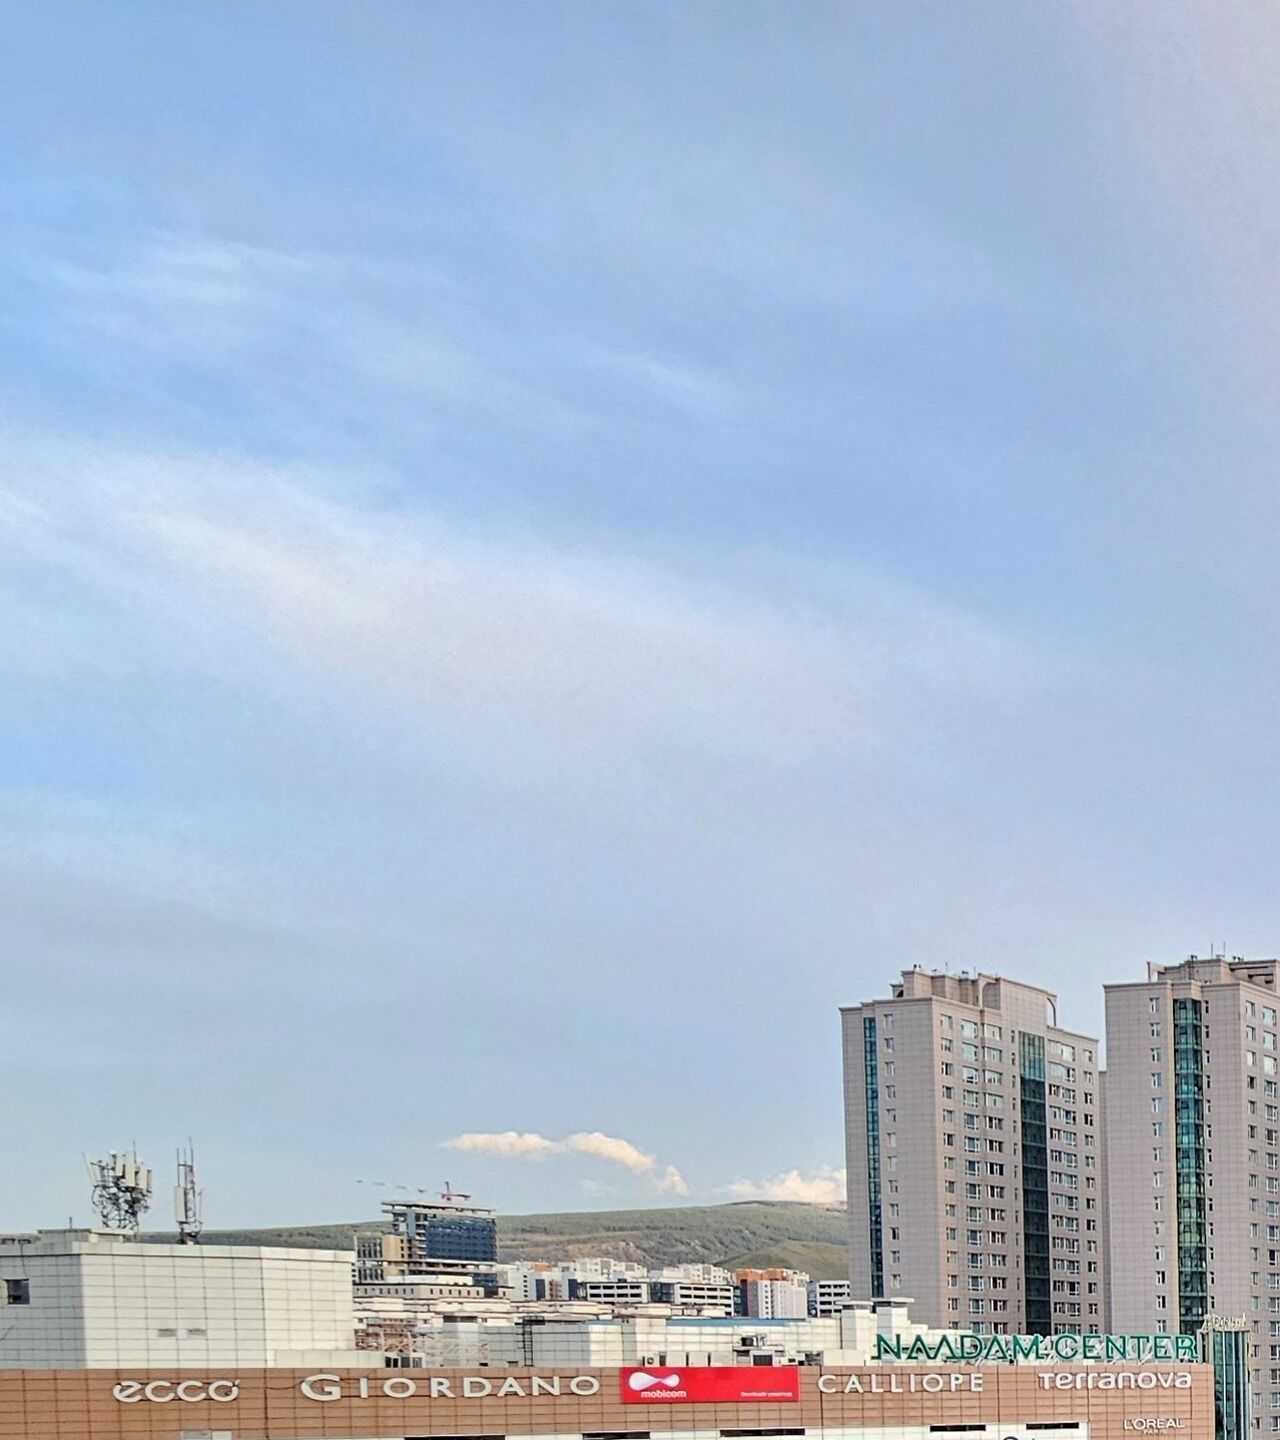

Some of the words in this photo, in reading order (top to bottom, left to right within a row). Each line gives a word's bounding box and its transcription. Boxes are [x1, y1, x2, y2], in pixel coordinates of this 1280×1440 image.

[871, 1333, 1047, 1360] NAADAM
[1054, 1334, 1199, 1360] CENTER
[112, 1380, 240, 1402] ecco
[817, 1373, 984, 1394] CALLIOPE
[1038, 1371, 1192, 1390] Terranova
[641, 1389, 687, 1399] mobicom
